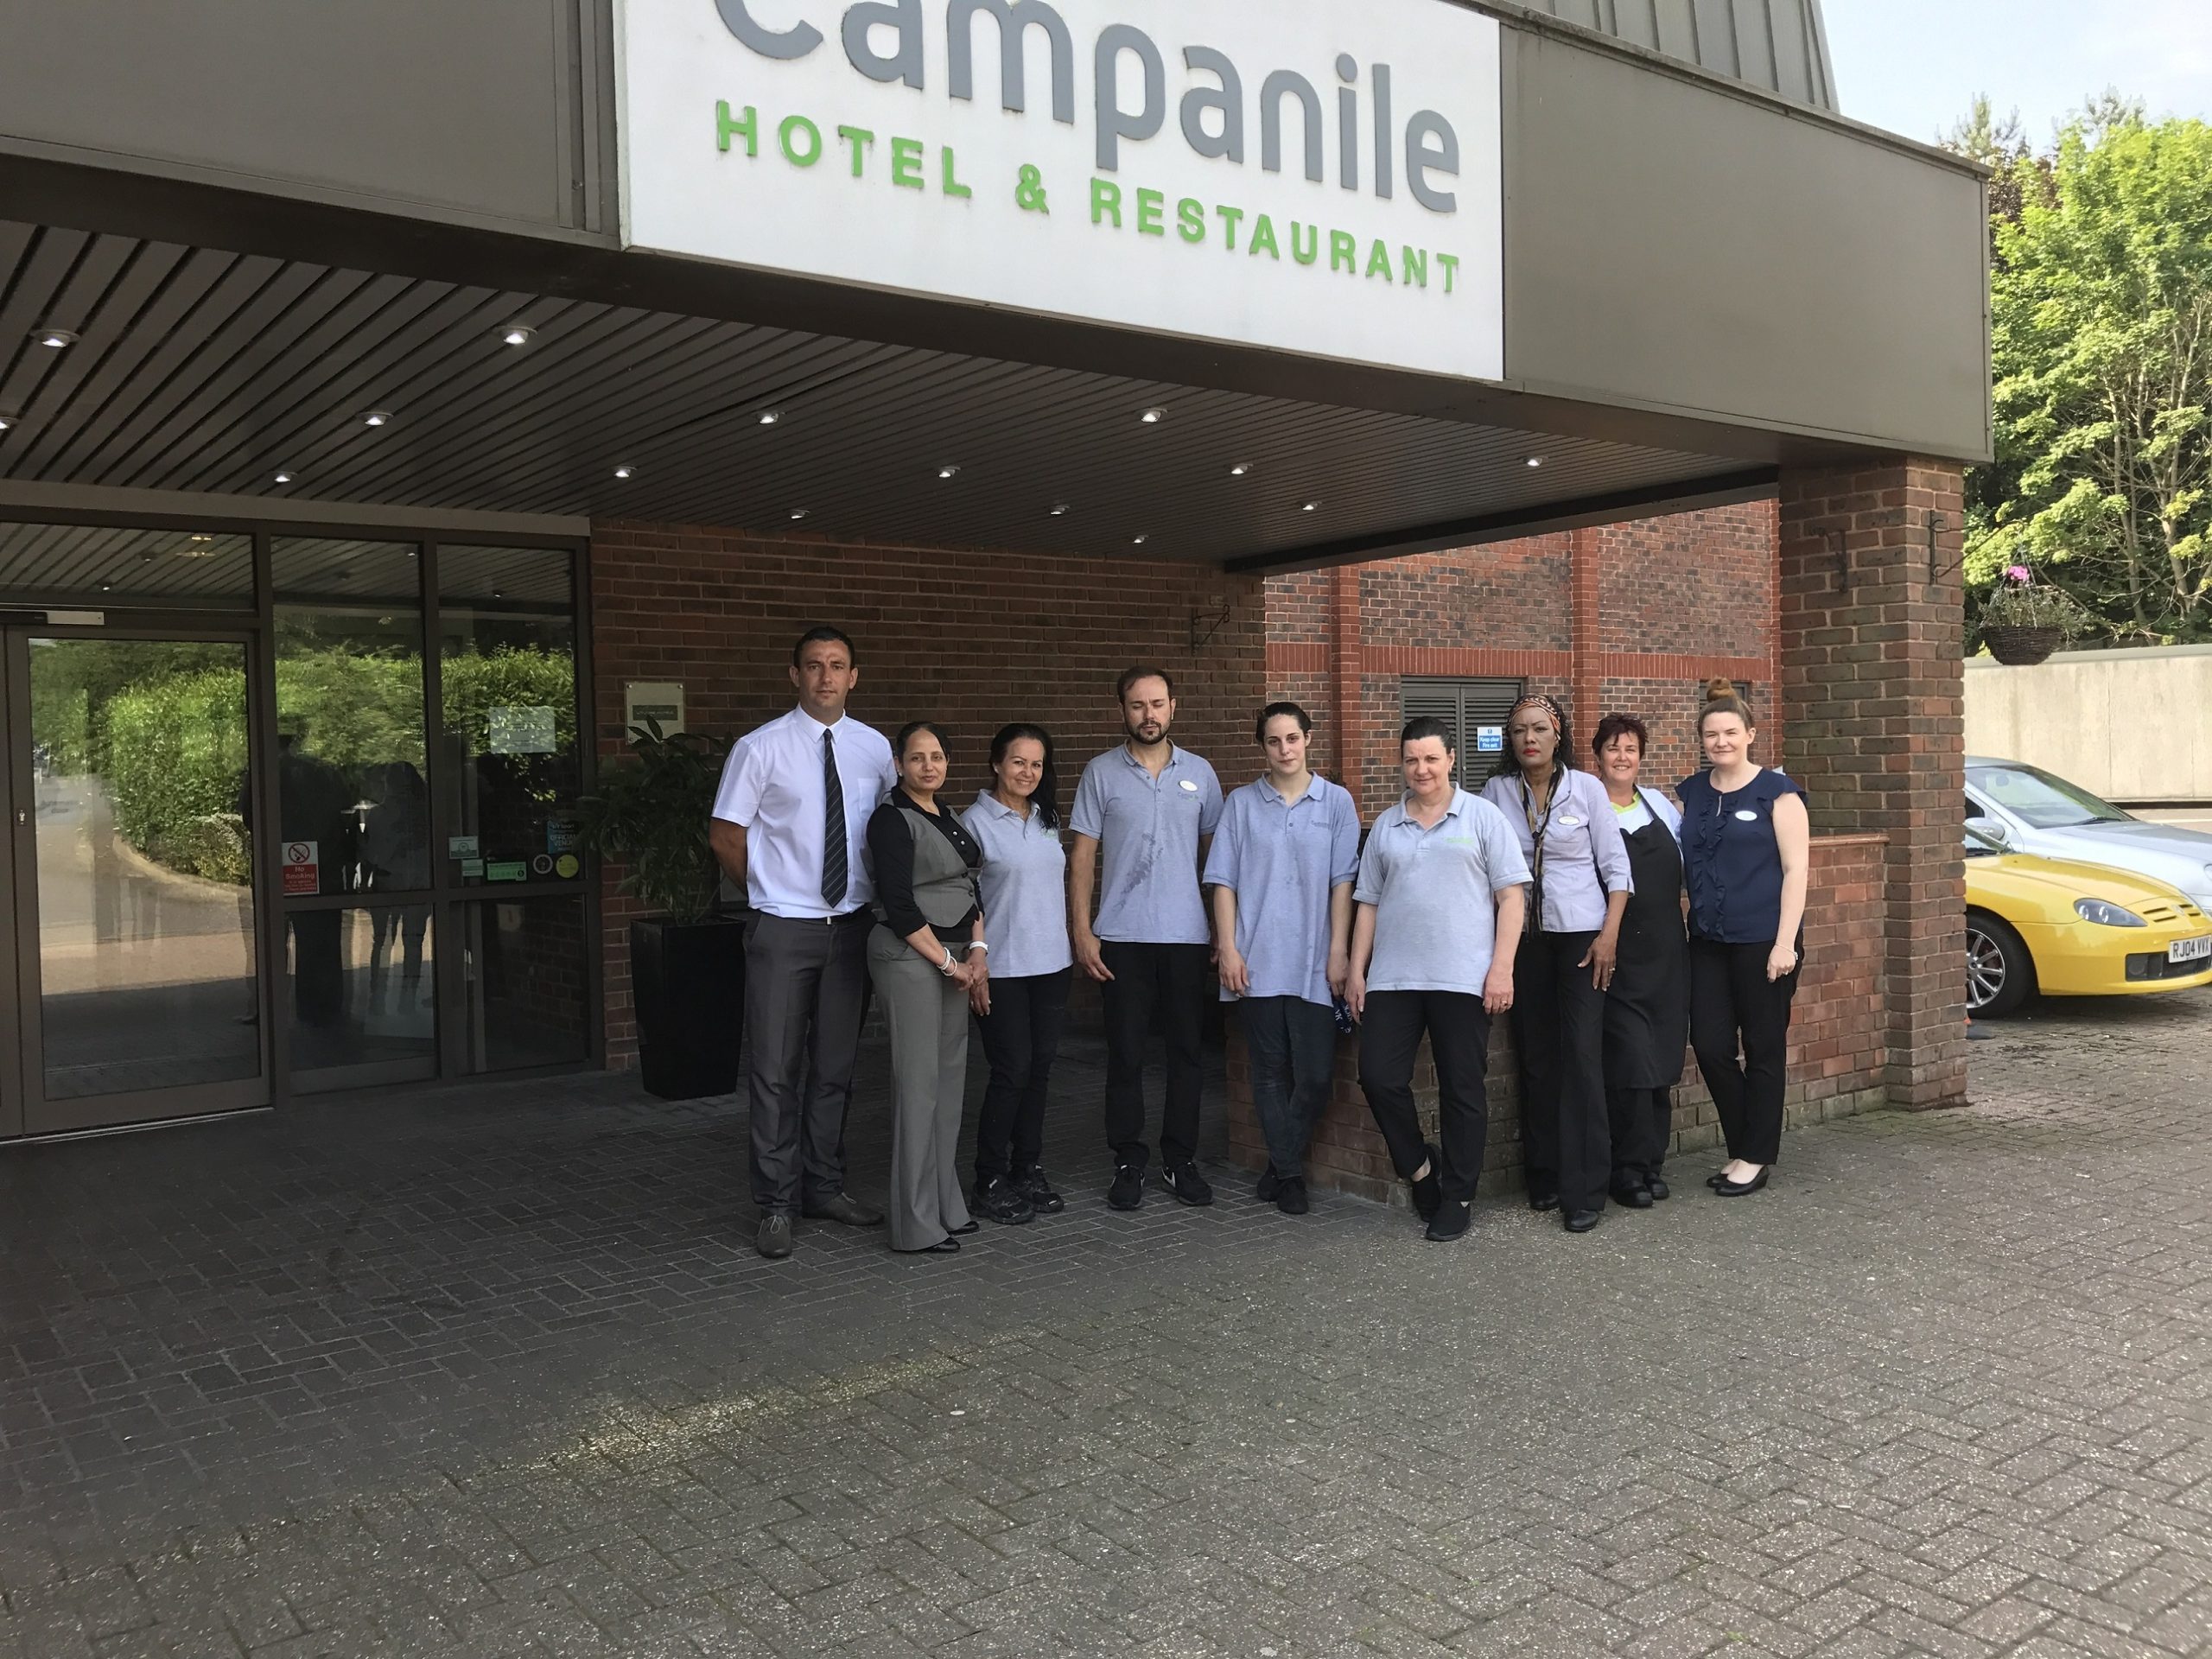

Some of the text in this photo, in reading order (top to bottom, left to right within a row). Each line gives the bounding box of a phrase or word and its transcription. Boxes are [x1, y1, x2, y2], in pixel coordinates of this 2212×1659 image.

[716, 99, 1459, 293] HOTEL & RESTAURANT
[2172, 940, 2196, 959] RJ04
